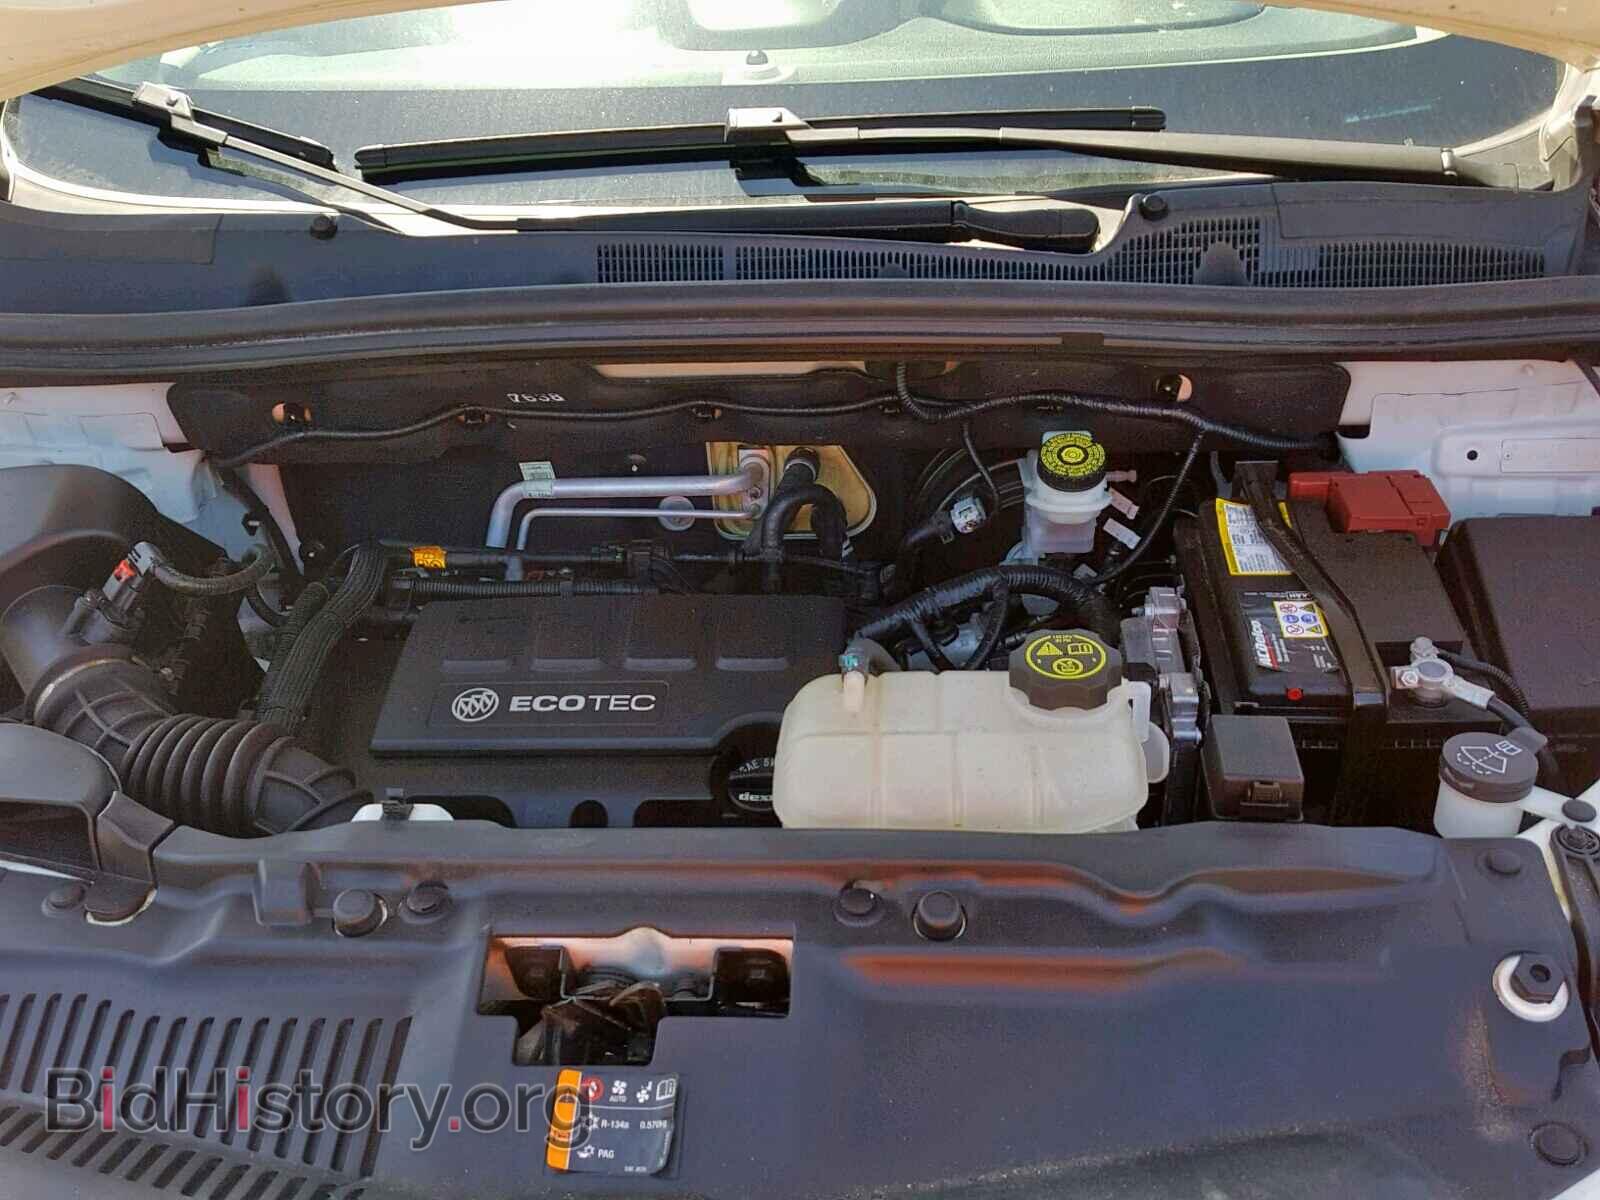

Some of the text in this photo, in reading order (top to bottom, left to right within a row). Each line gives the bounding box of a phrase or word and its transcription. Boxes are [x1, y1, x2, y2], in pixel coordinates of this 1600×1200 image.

[509, 695, 656, 711] ECOTEC
[609, 1095, 627, 1103] AUTO
[600, 1119, 630, 1129] R-134a
[597, 1148, 615, 1159] PAG
